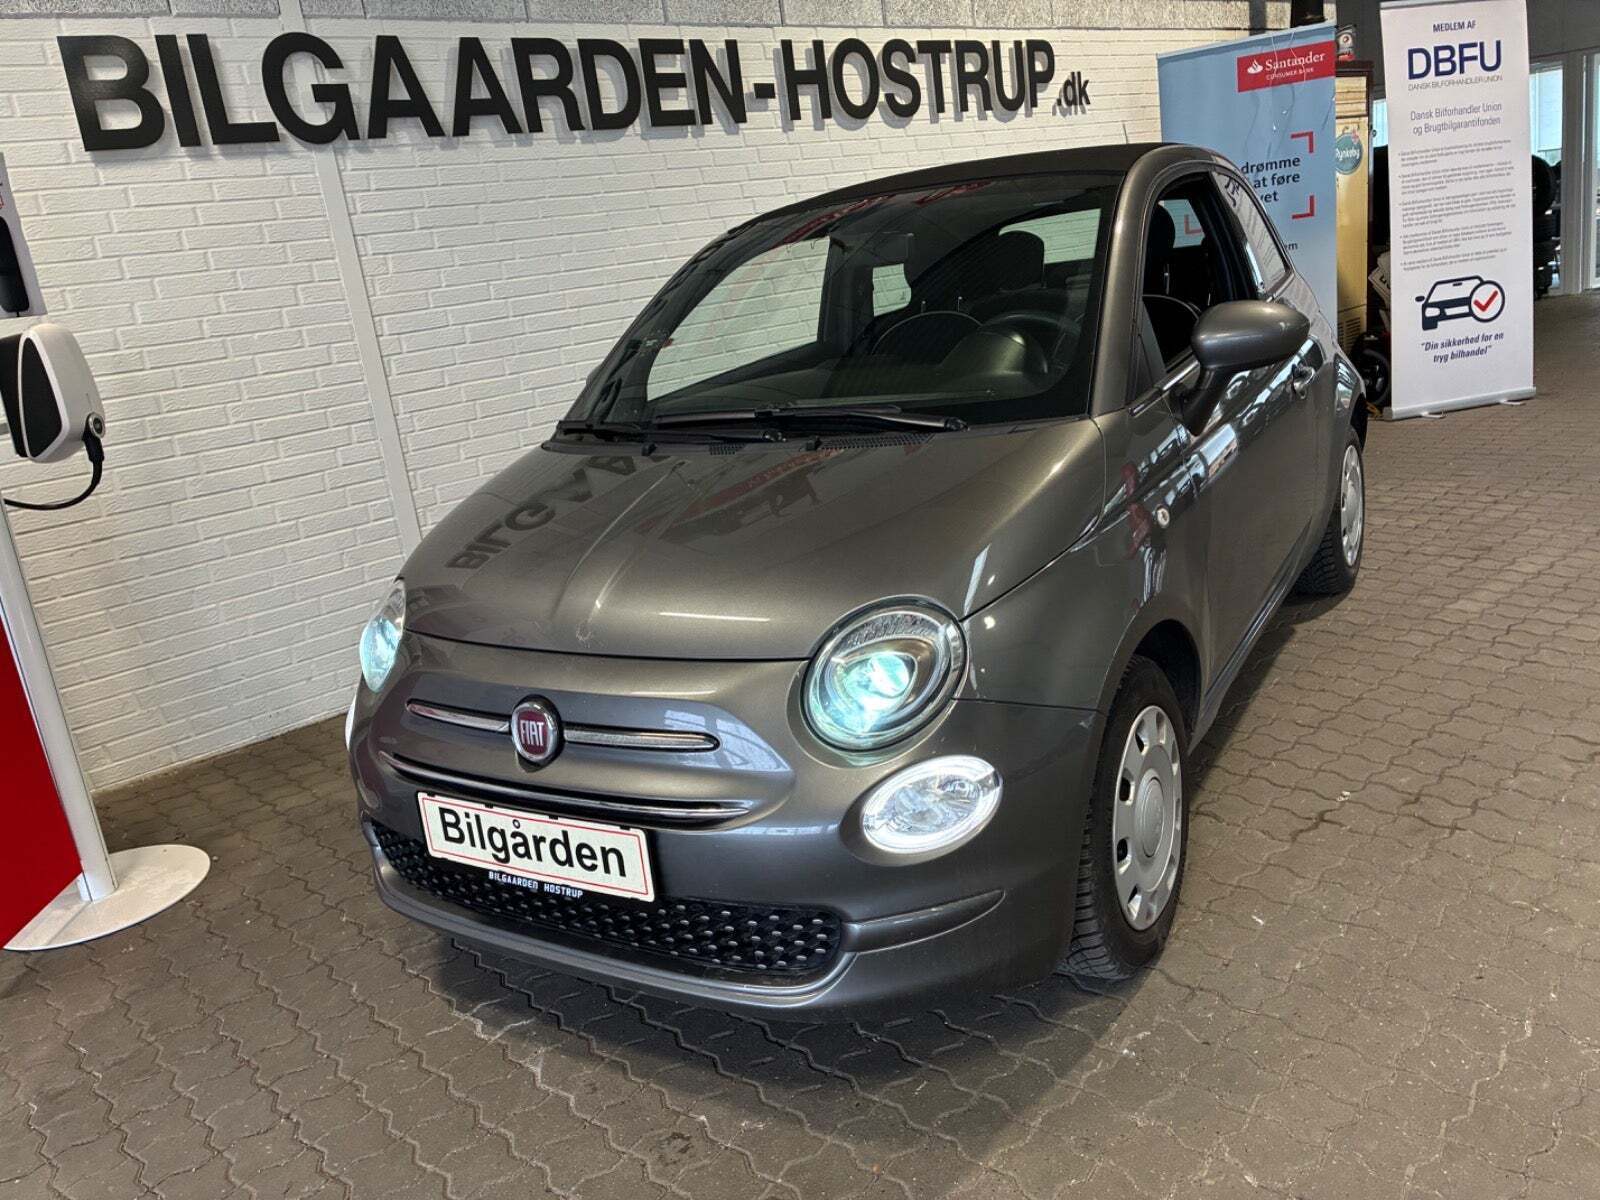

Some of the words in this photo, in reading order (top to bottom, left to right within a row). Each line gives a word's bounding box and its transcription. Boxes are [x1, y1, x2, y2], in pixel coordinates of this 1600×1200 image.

[1433, 21, 1465, 32] MEDLEM
[1467, 20, 1477, 30] AF
[1265, 51, 1326, 71] Santander
[1407, 40, 1501, 80] DBFU
[1408, 83, 1431, 92] DANSK
[1432, 77, 1482, 89] BILFORHANDLER
[1483, 75, 1504, 83] UNION
[1410, 110, 1434, 121] Dansk
[1435, 104, 1481, 118] Bilforhandler
[1482, 102, 1502, 113] Union
[1413, 126, 1423, 136] og
[1424, 116, 1501, 134] Brugtbilgarantifonden
[1241, 157, 1301, 174] drømme
[1254, 176, 1268, 188] at
[1271, 172, 1301, 186] føre
[1440, 333, 1480, 348] sikkerhed
[1481, 333, 1493, 343] for
[1493, 332, 1505, 341] en
[1433, 351, 1449, 363] tryg
[520, 719, 544, 747] FIAT
[438, 806, 627, 878] Bilgården
[488, 871, 539, 890] BILGAARDEN
[543, 882, 583, 899] HOSTRUP
